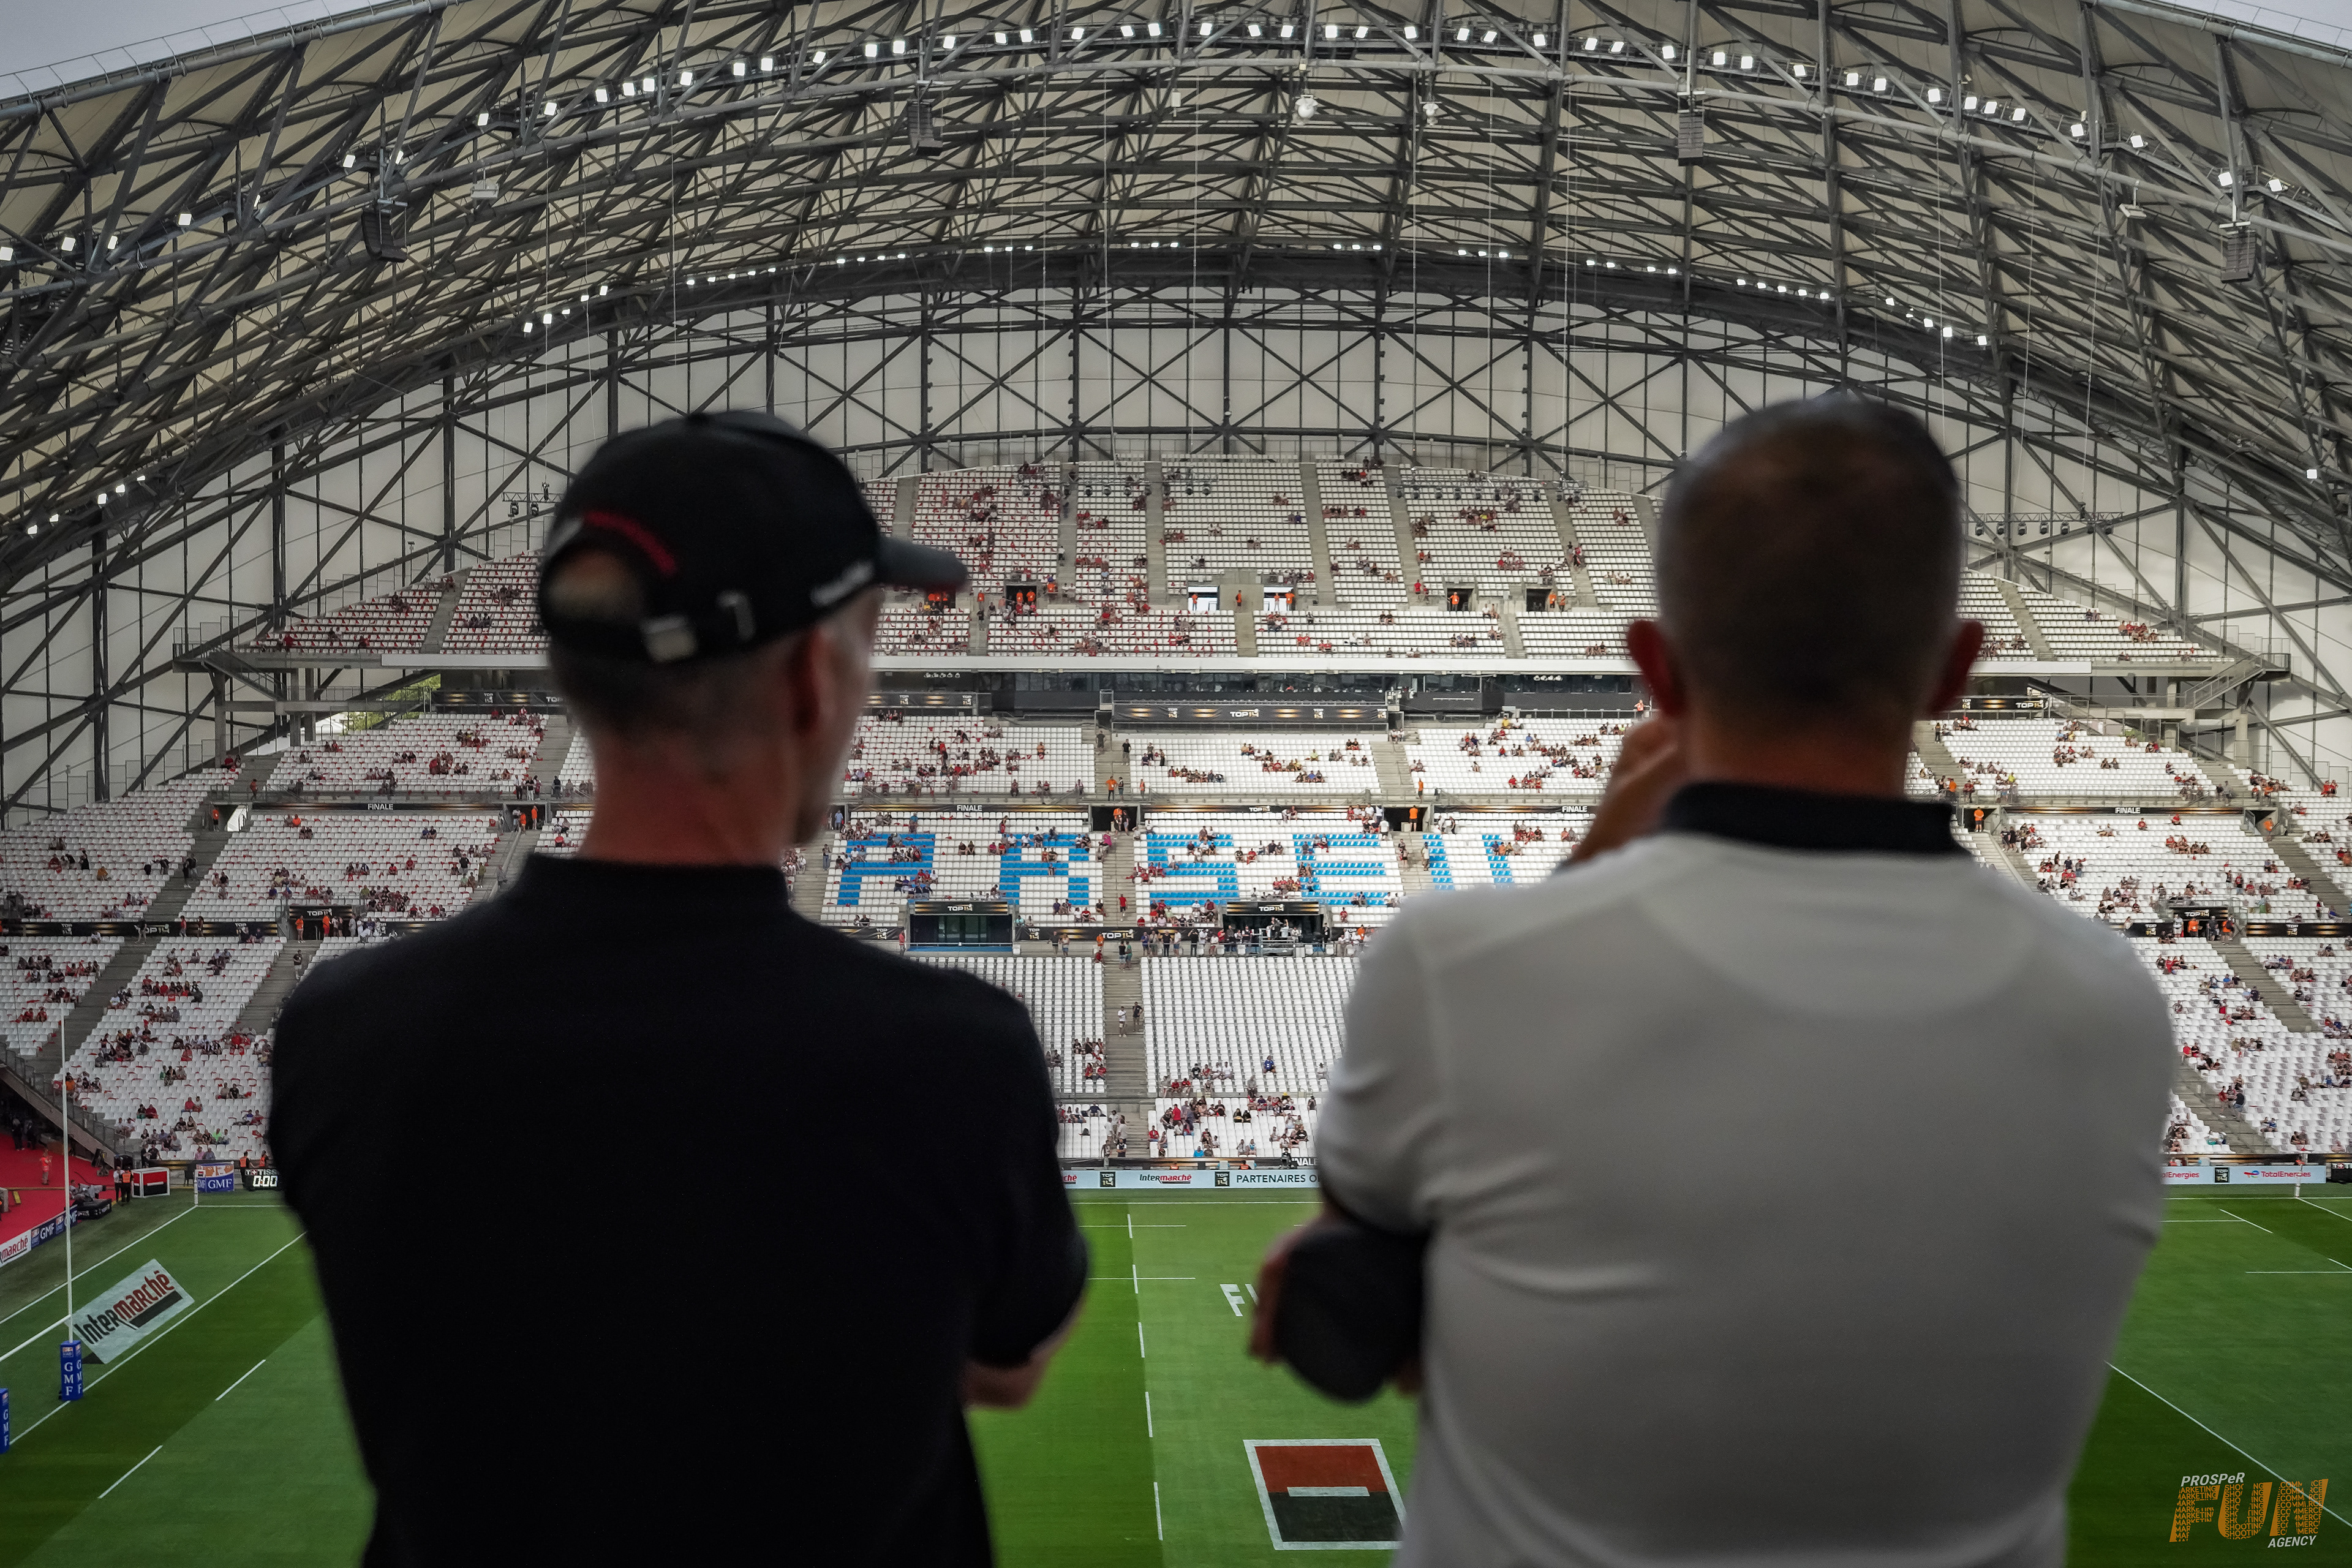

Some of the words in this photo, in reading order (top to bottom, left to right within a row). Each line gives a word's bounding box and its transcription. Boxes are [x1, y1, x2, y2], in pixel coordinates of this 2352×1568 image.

[208, 1178, 233, 1189] GMF
[1139, 1174, 1192, 1183] Intermarché
[1237, 1174, 1306, 1183] PARTENAIRES
[40, 1223, 55, 1240] GMF
[74, 1270, 175, 1344] Intermarché
